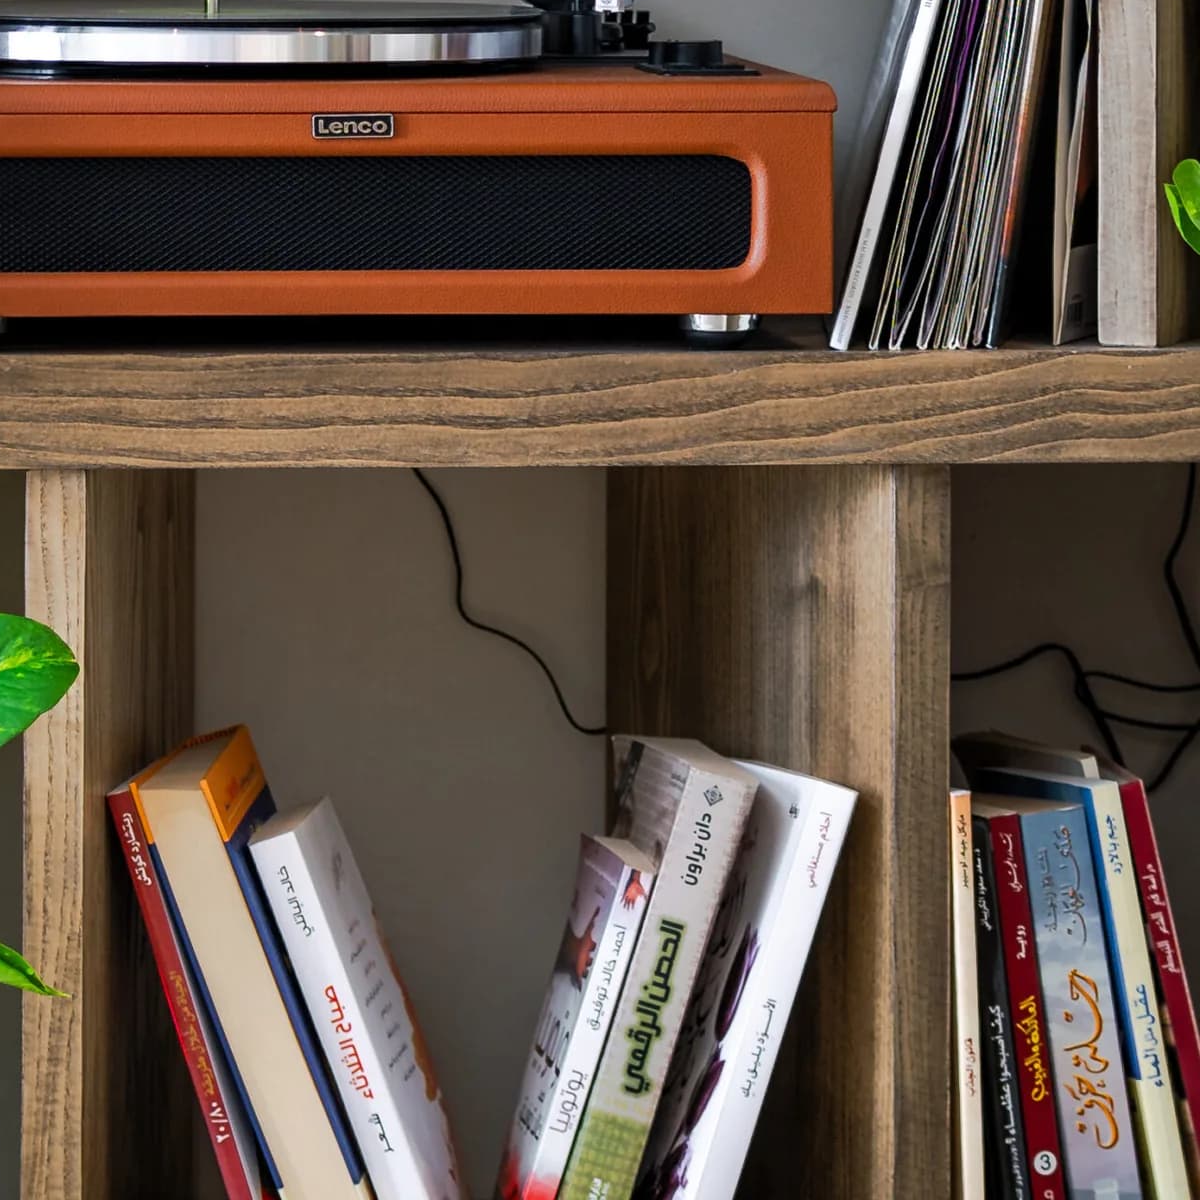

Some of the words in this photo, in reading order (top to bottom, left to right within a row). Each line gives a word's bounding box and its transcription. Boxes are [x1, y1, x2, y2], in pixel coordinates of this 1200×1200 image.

[318, 119, 388, 135] Lenco
[123, 813, 140, 852] ريتشارد
[694, 813, 711, 840] دان
[820, 812, 832, 841] أحلام
[958, 814, 967, 837] مايكل
[1106, 816, 1115, 839] جيم
[681, 843, 707, 885] براون
[1109, 843, 1123, 873] بالارد
[280, 866, 294, 892] خالد
[1142, 864, 1157, 890] دراسة
[613, 924, 627, 956] أحمد
[1016, 925, 1027, 959] رواية
[602, 960, 616, 985] خالد
[642, 920, 684, 1003] الحصن
[587, 987, 608, 1030] توفيق
[989, 1005, 1004, 1033] كيف
[325, 986, 351, 1032] صباح
[339, 1039, 373, 1098] الثلاثاء
[624, 995, 662, 1095] الرقمي
[1135, 985, 1155, 1024] عقل
[1145, 1049, 1164, 1087] الماء
[992, 1035, 1011, 1082] أصبحوا
[549, 1070, 587, 1133] يوتوبيا
[370, 1114, 393, 1152] شعر
